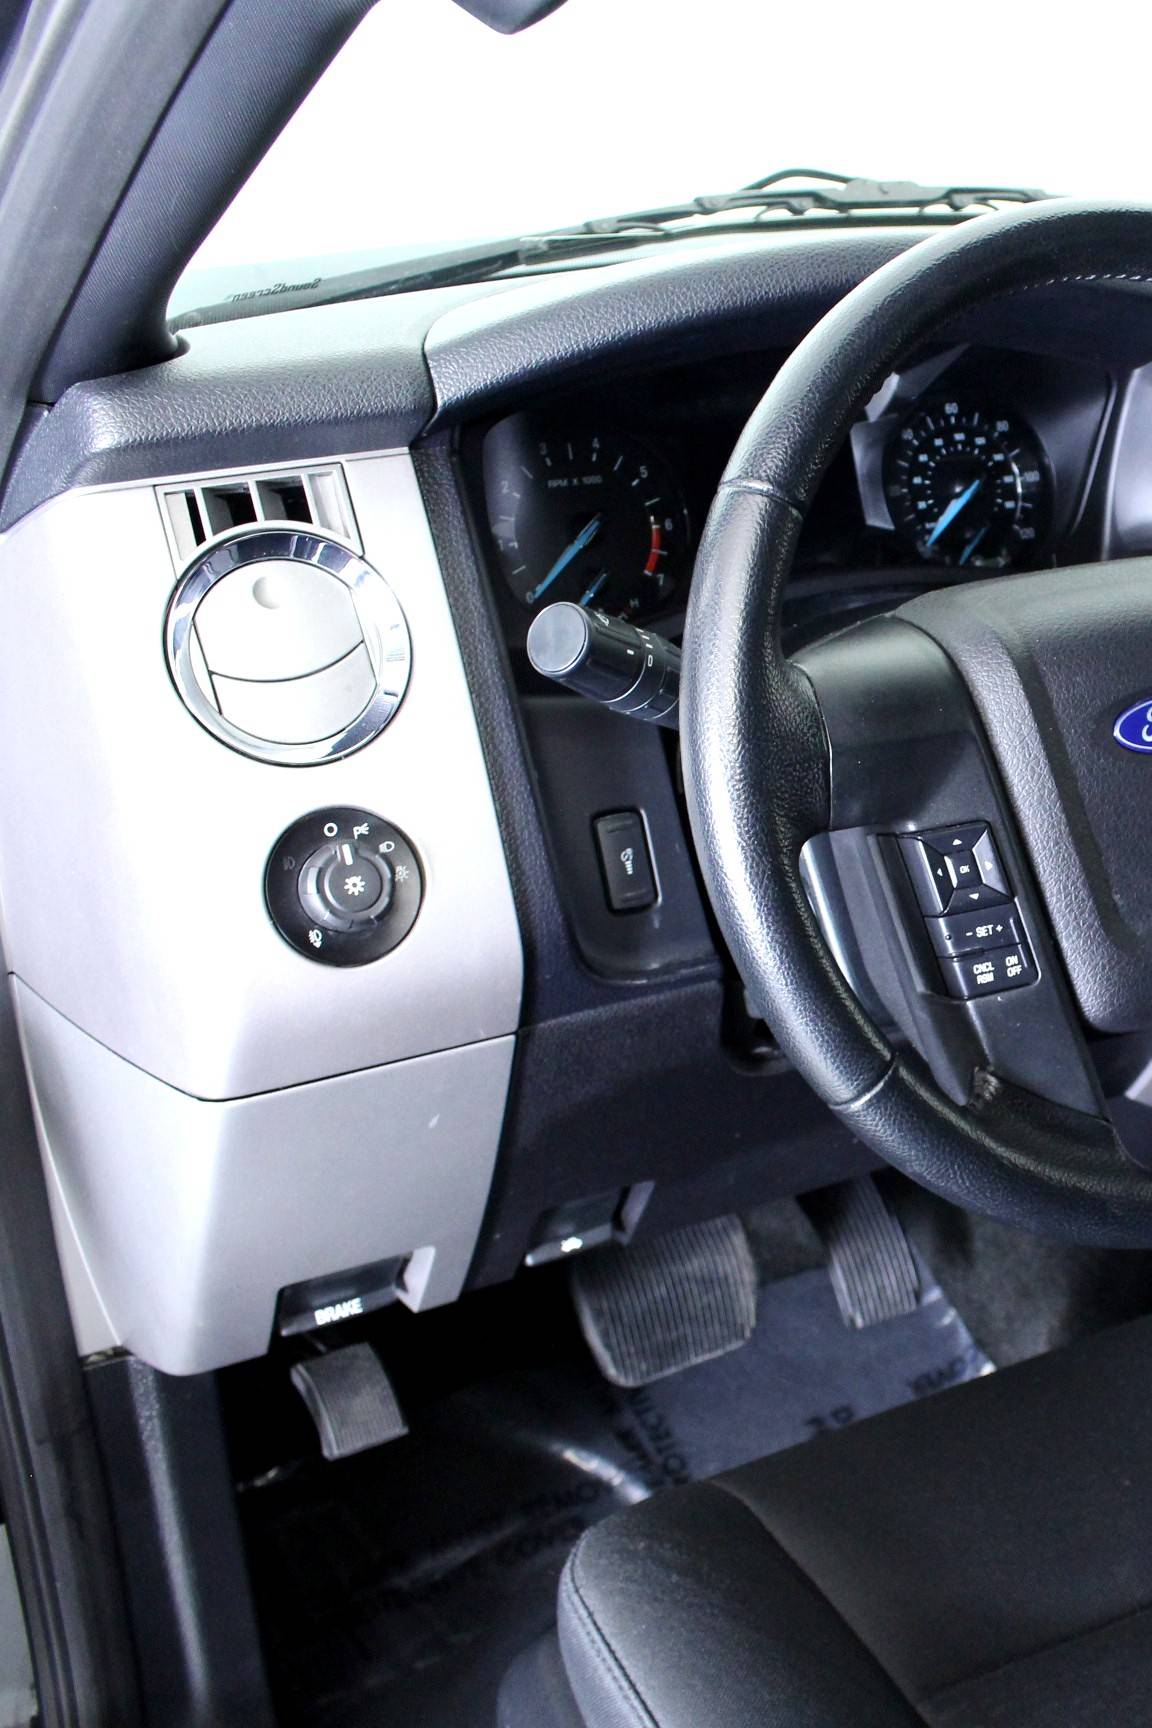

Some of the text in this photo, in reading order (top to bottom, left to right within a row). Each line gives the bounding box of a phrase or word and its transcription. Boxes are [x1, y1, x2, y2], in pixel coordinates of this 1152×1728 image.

[640, 465, 649, 479] 5
[501, 481, 511, 493] 2
[959, 865, 970, 874] OK
[975, 924, 993, 938] SET
[1005, 954, 1019, 966] ON
[972, 961, 995, 975] CNCL
[1006, 965, 1023, 978] OFF
[314, 1296, 364, 1326] BRAKE
